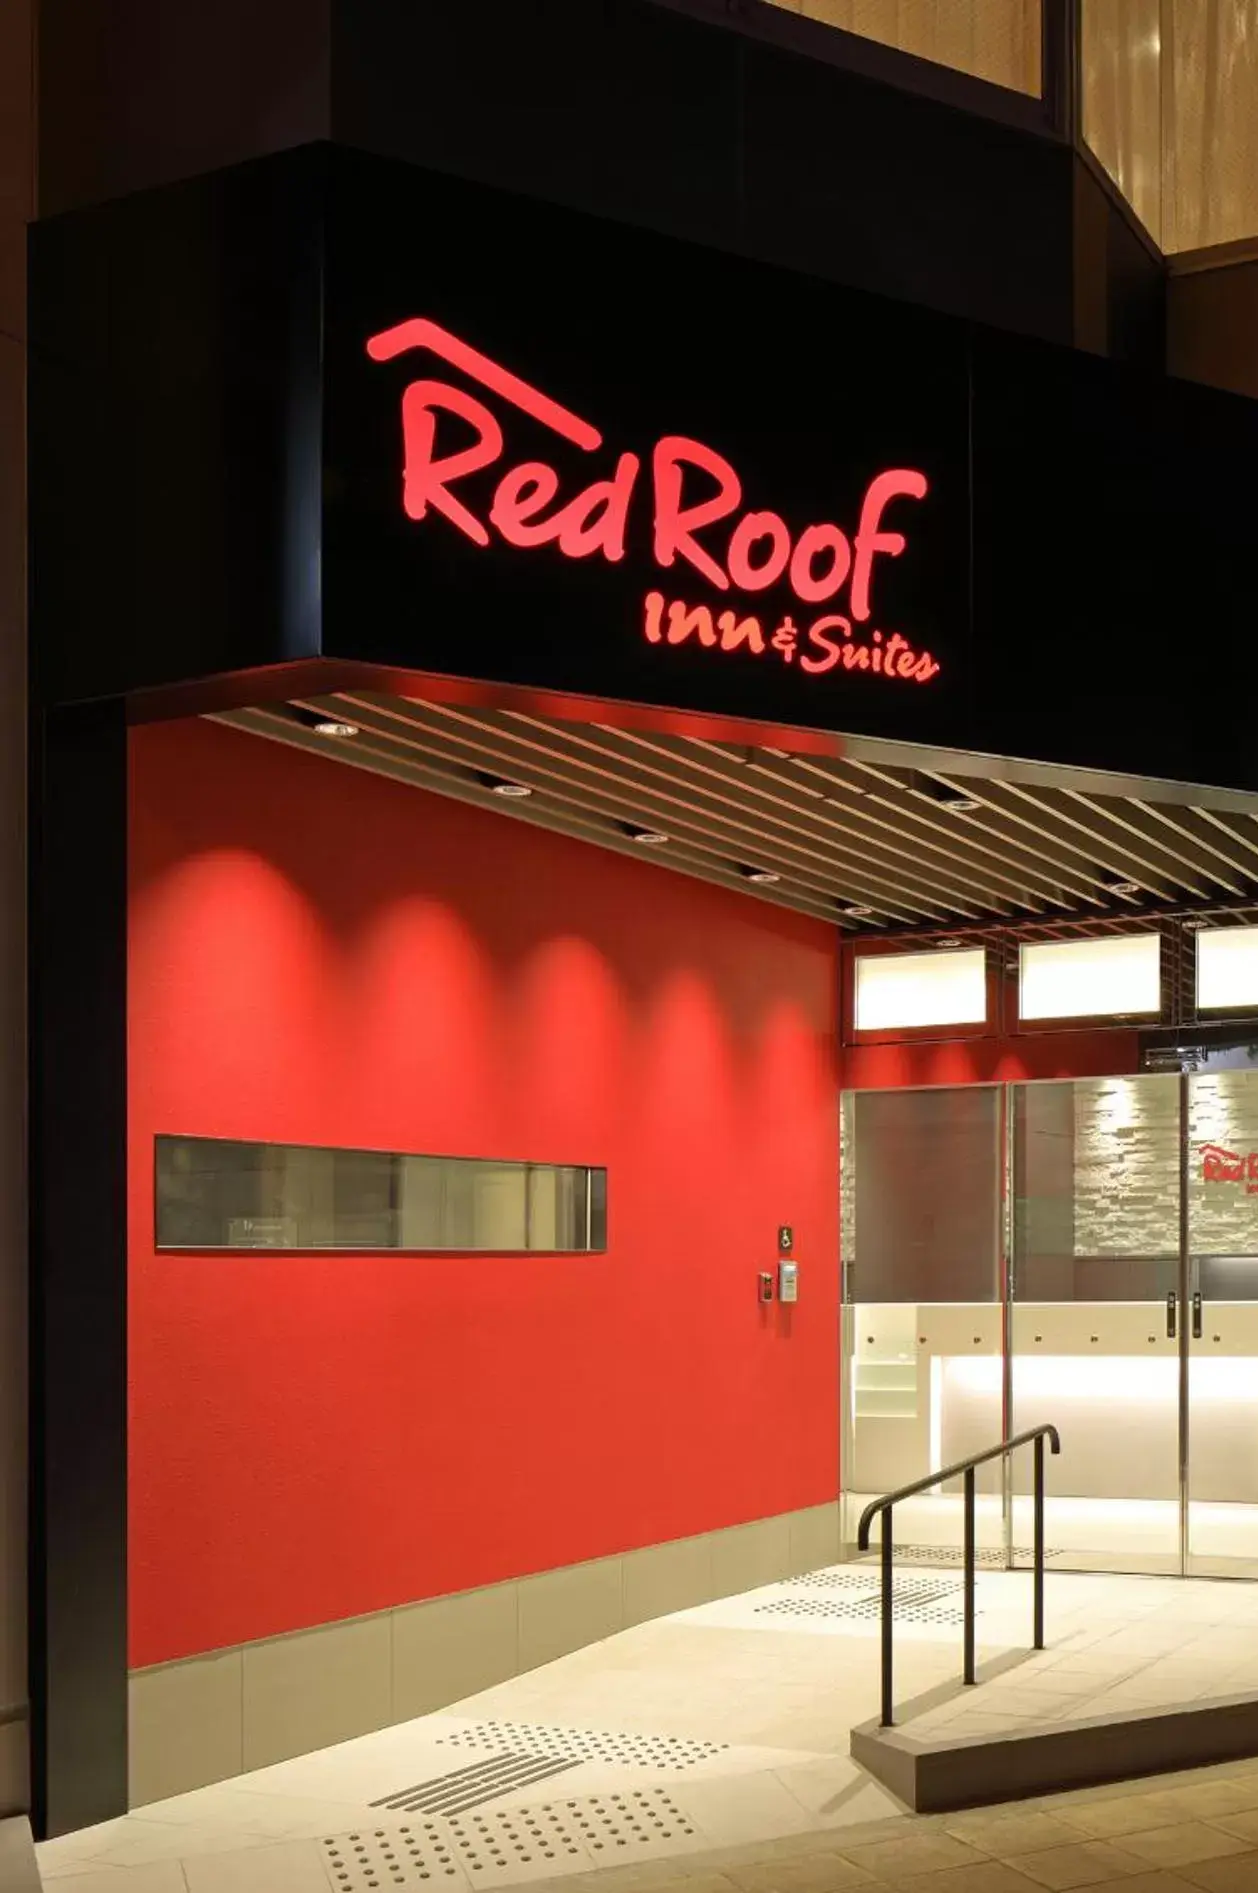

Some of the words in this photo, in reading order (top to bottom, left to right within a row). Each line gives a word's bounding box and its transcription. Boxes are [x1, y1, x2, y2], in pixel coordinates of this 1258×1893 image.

[402, 380, 640, 562] Red
[653, 436, 927, 621] Roof
[645, 591, 765, 654] Inn
[771, 616, 798, 662] &
[800, 615, 940, 682] Suites
